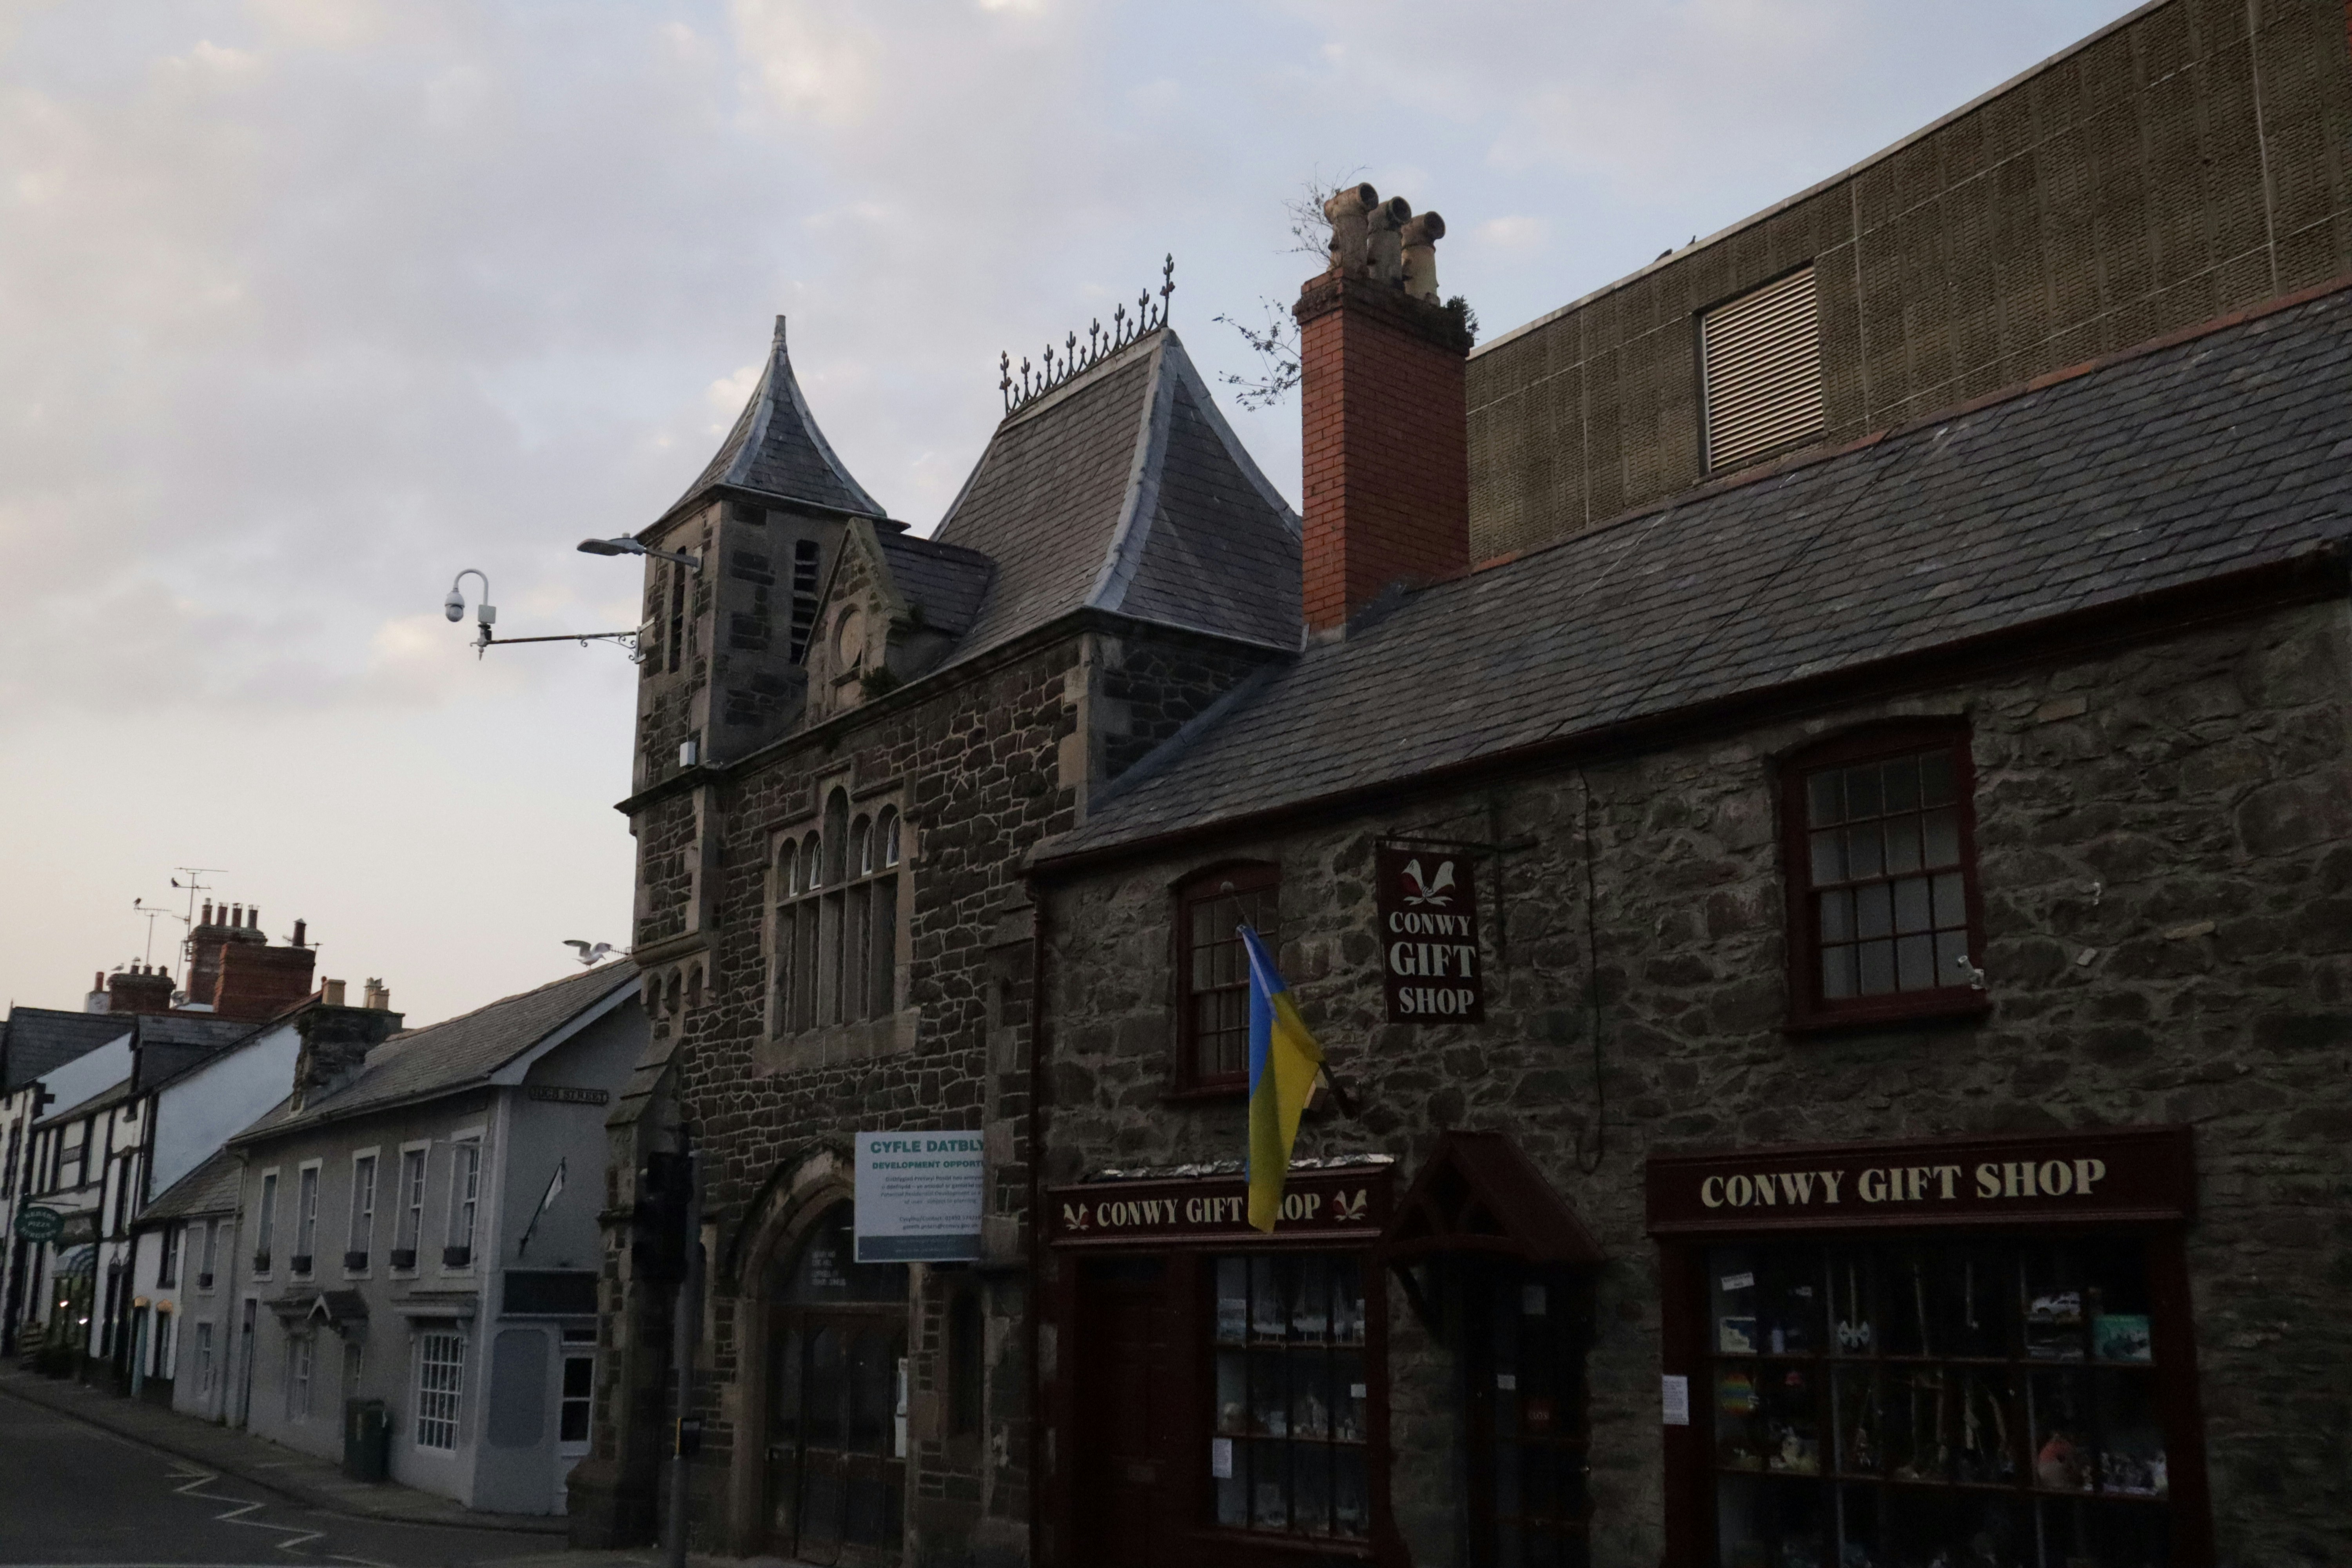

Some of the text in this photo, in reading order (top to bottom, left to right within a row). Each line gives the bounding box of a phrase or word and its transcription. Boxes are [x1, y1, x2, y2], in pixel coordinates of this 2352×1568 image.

[1389, 911, 1471, 936] CONWY
[1390, 942, 1476, 978] GIFT
[1399, 986, 1474, 1014] SHOP
[563, 1089, 604, 1103] STREET
[870, 1141, 921, 1153] CYFLE
[872, 1161, 941, 1169] DEVELOPMENT
[1700, 1158, 2106, 1208] CONWY GIFT SHOP
[1097, 1193, 1321, 1227] CONWY GIFT OP
